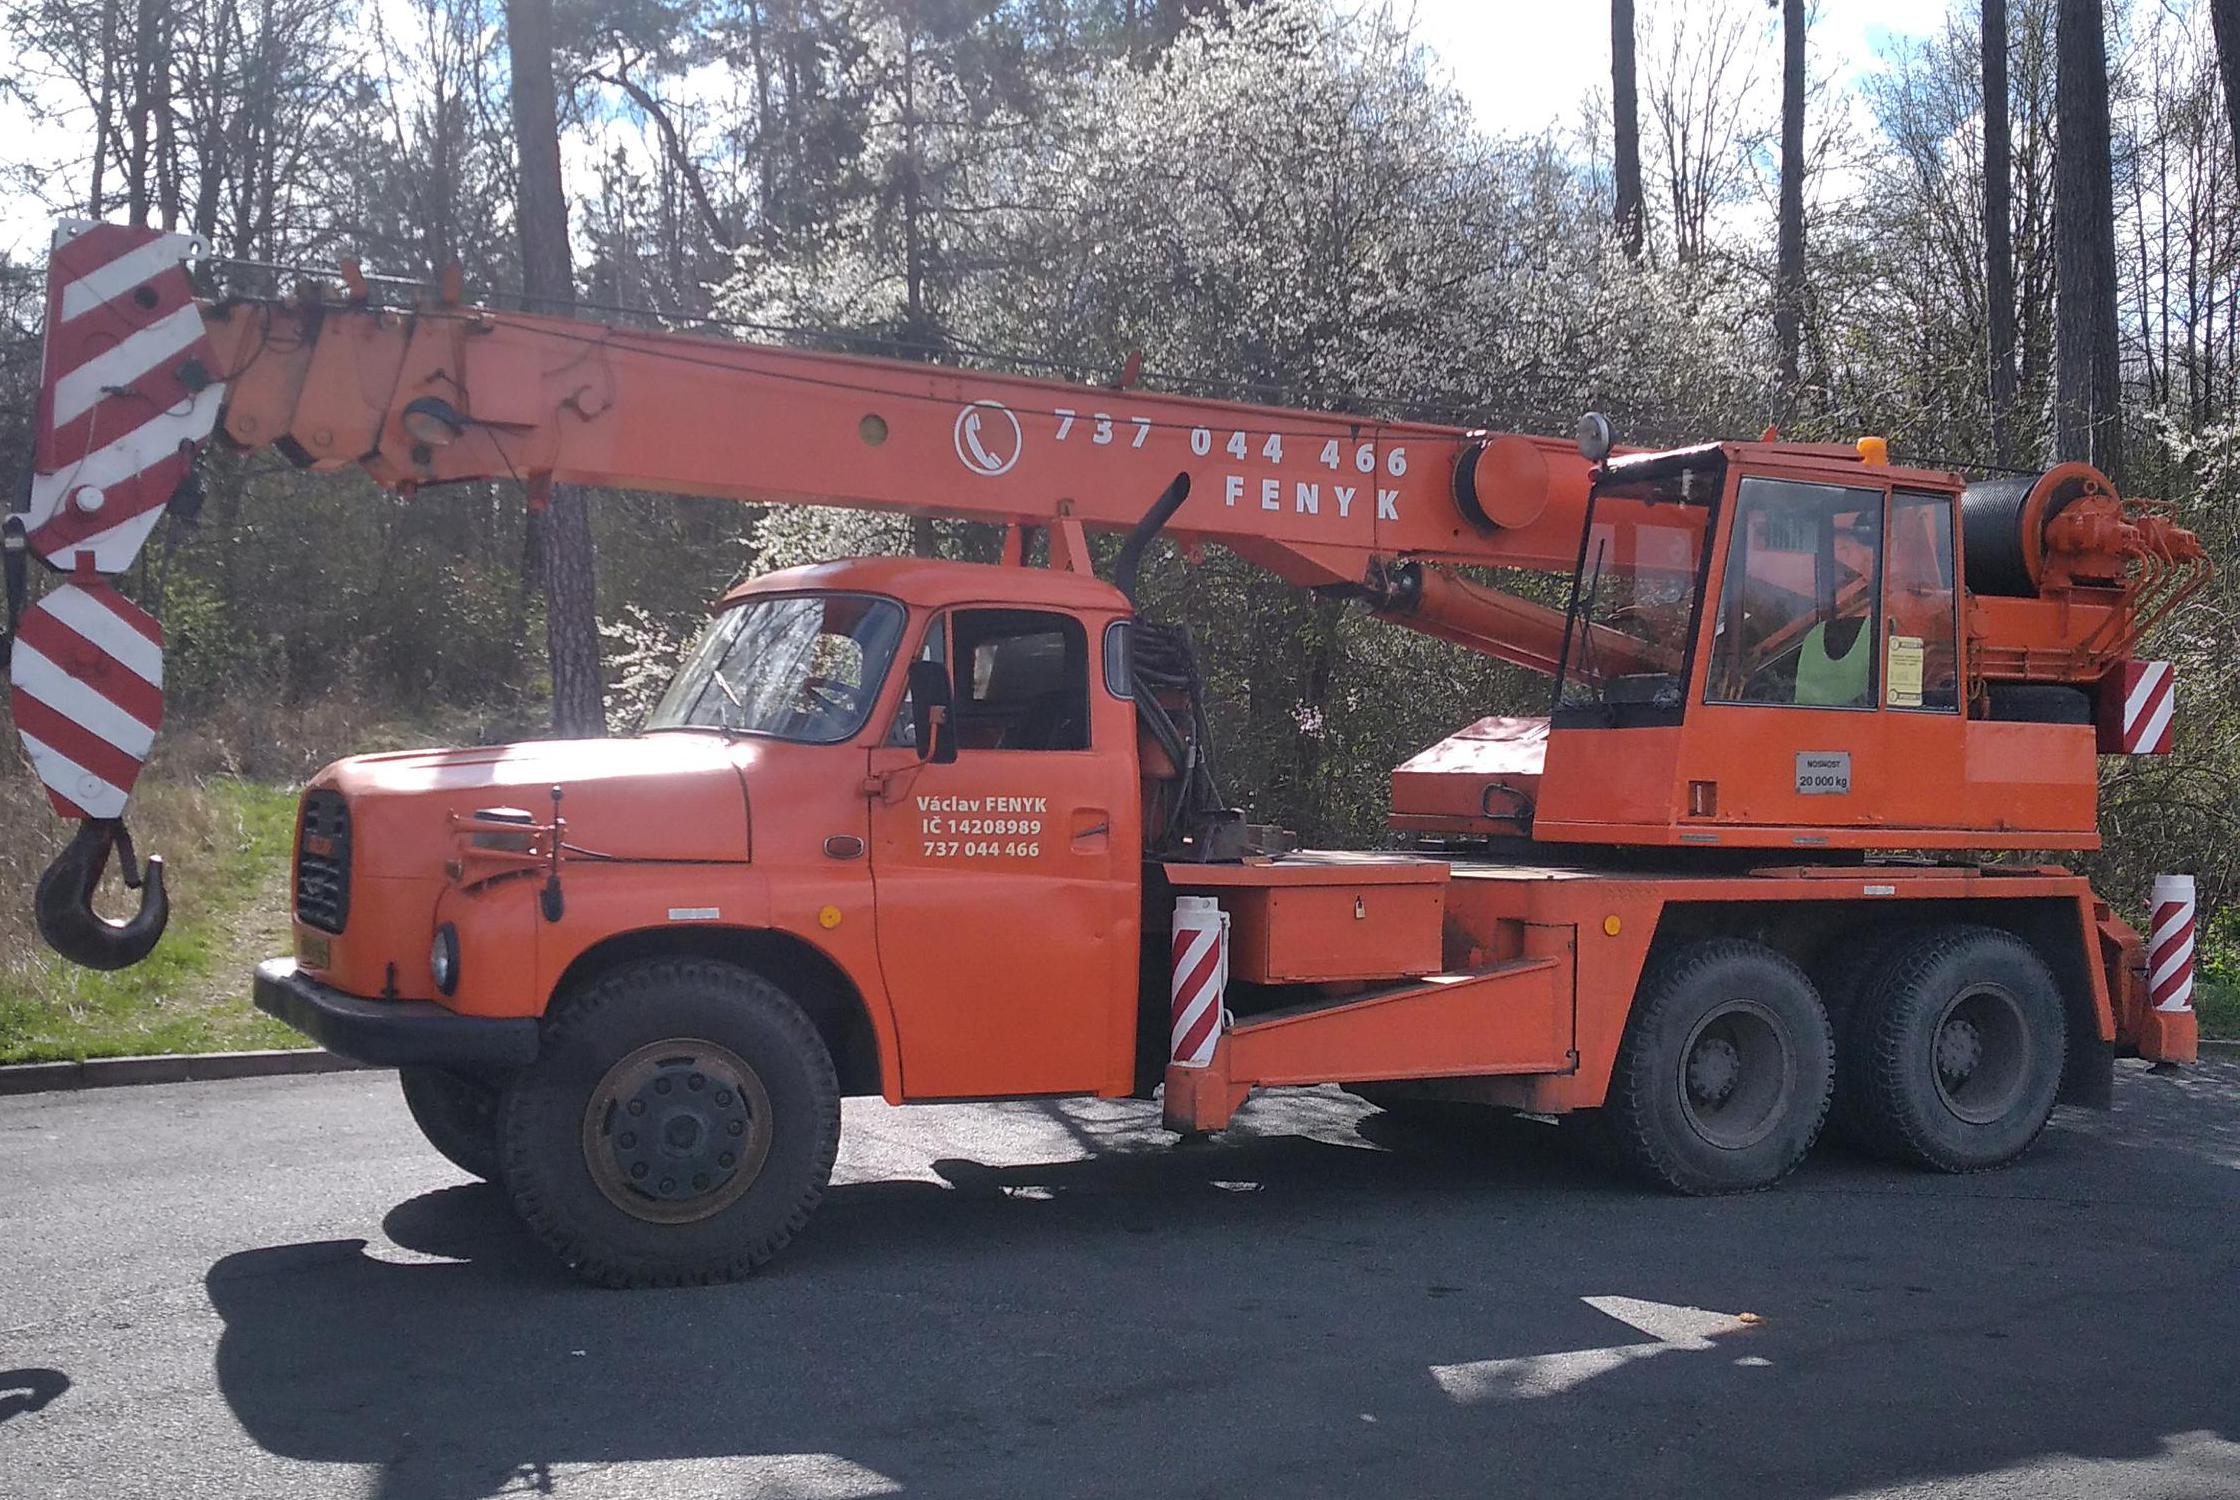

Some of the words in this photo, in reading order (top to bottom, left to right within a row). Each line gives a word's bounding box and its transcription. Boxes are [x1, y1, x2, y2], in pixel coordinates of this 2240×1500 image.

[1054, 409, 1151, 448] 737
[1190, 426, 1283, 464] 044
[1320, 441, 1407, 476] 466
[1225, 475, 1399, 520] FENYK
[1807, 760, 1840, 768] NOSNOST
[1800, 776, 1813, 786] 20
[1815, 776, 1834, 786] 000
[1835, 776, 1847, 788] kg
[916, 796, 980, 812] Václav
[985, 797, 1046, 812] FENYK
[923, 816, 941, 833] IČ
[948, 820, 1041, 834] 14208989
[924, 842, 959, 856] 737
[965, 842, 999, 856] 044
[1005, 842, 1039, 857] 466
